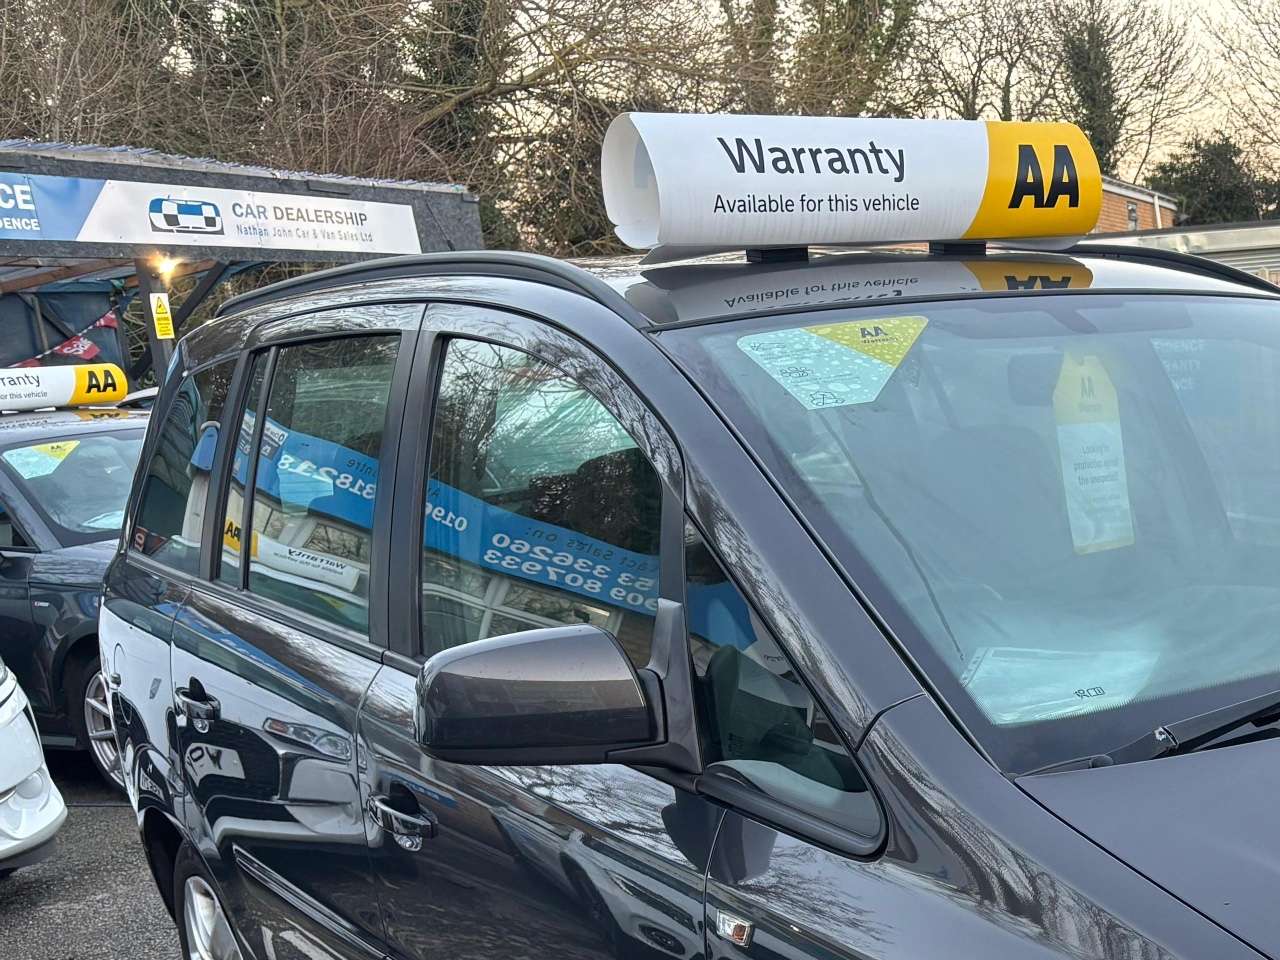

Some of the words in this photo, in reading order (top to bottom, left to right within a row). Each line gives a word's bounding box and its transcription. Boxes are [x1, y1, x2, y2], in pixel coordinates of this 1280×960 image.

[717, 136, 906, 182] Warranty
[1008, 144, 1079, 209] AA
[232, 202, 268, 220] CAR
[273, 206, 368, 226] DEALERSHIP
[713, 193, 795, 214] Available
[799, 192, 825, 212] for
[828, 192, 859, 212] this
[862, 193, 920, 213] vehicle
[236, 224, 269, 237] Nathan
[272, 227, 294, 238] John
[295, 228, 310, 239] Car
[321, 230, 336, 241] Van
[337, 231, 359, 242] Sales
[360, 232, 374, 243] Ltd
[860, 326, 888, 338] AA
[85, 370, 117, 393] AA
[10, 391, 22, 399] this
[23, 390, 48, 399] vehicle
